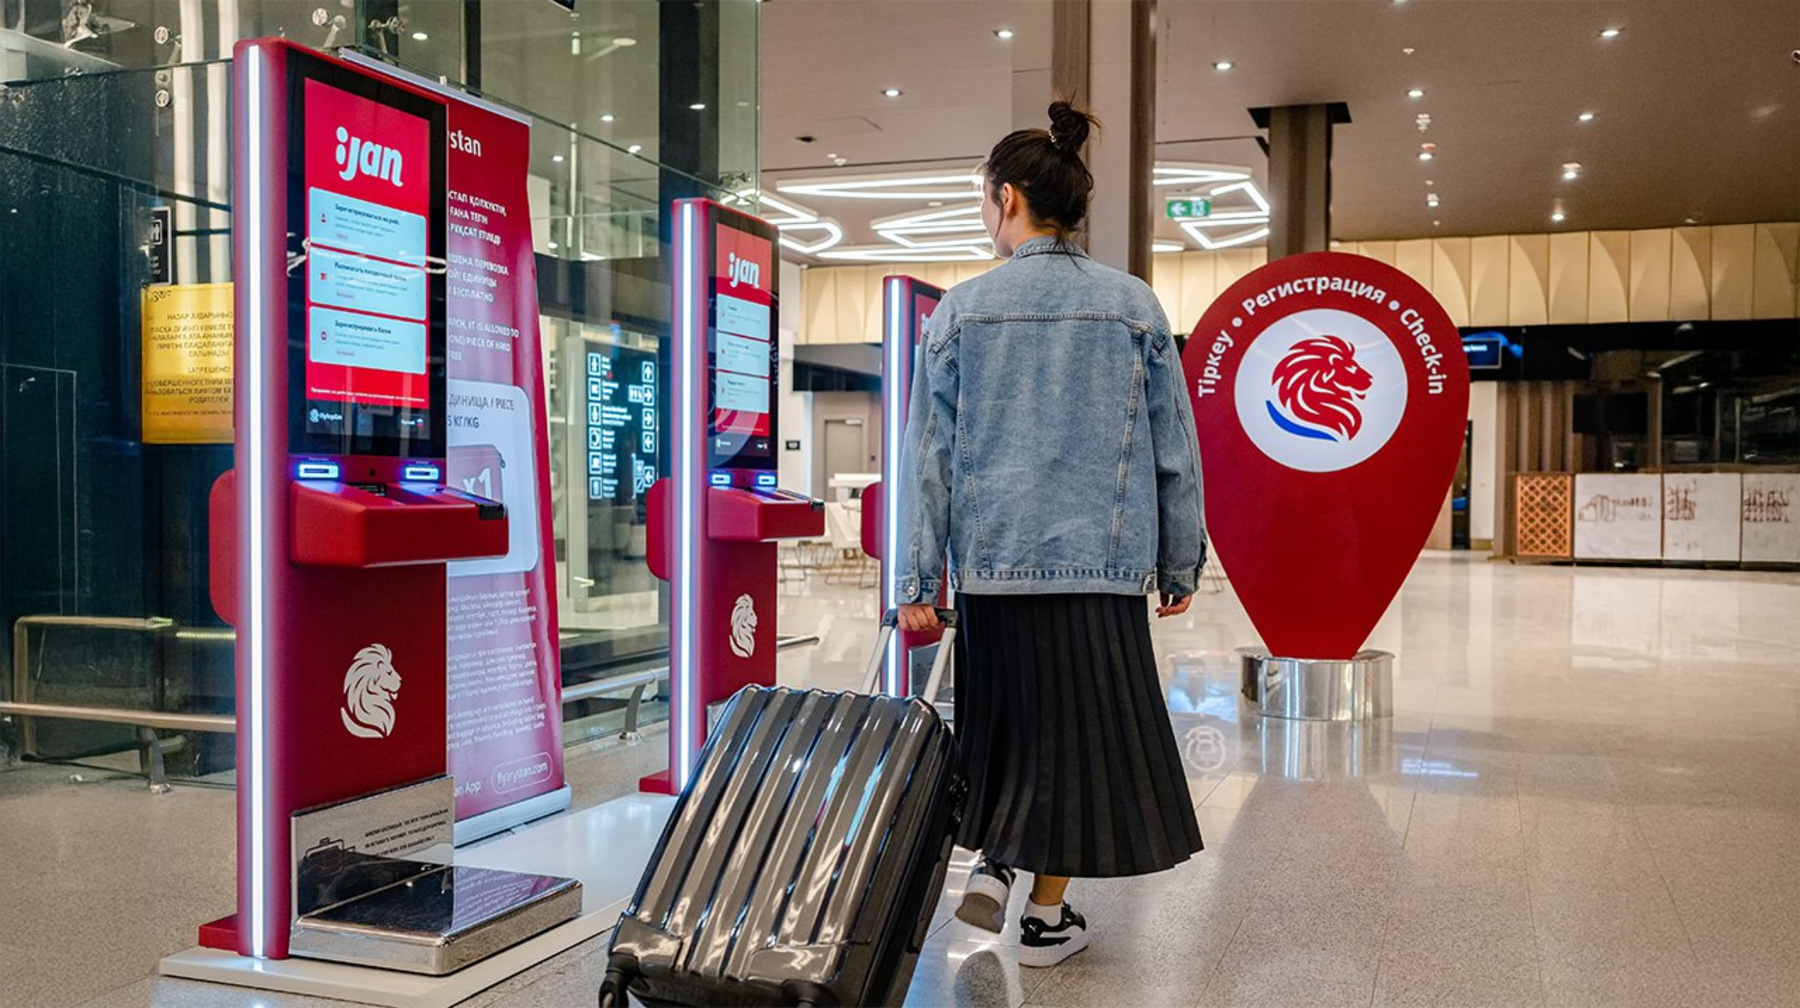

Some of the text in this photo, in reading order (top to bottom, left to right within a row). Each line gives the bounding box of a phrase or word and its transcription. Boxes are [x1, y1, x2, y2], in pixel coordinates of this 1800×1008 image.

[448, 129, 482, 157] stan
[1198, 275, 1447, 398] Тіркеу Регистрация Check-in
[497, 762, 548, 787] flyarystan.com
